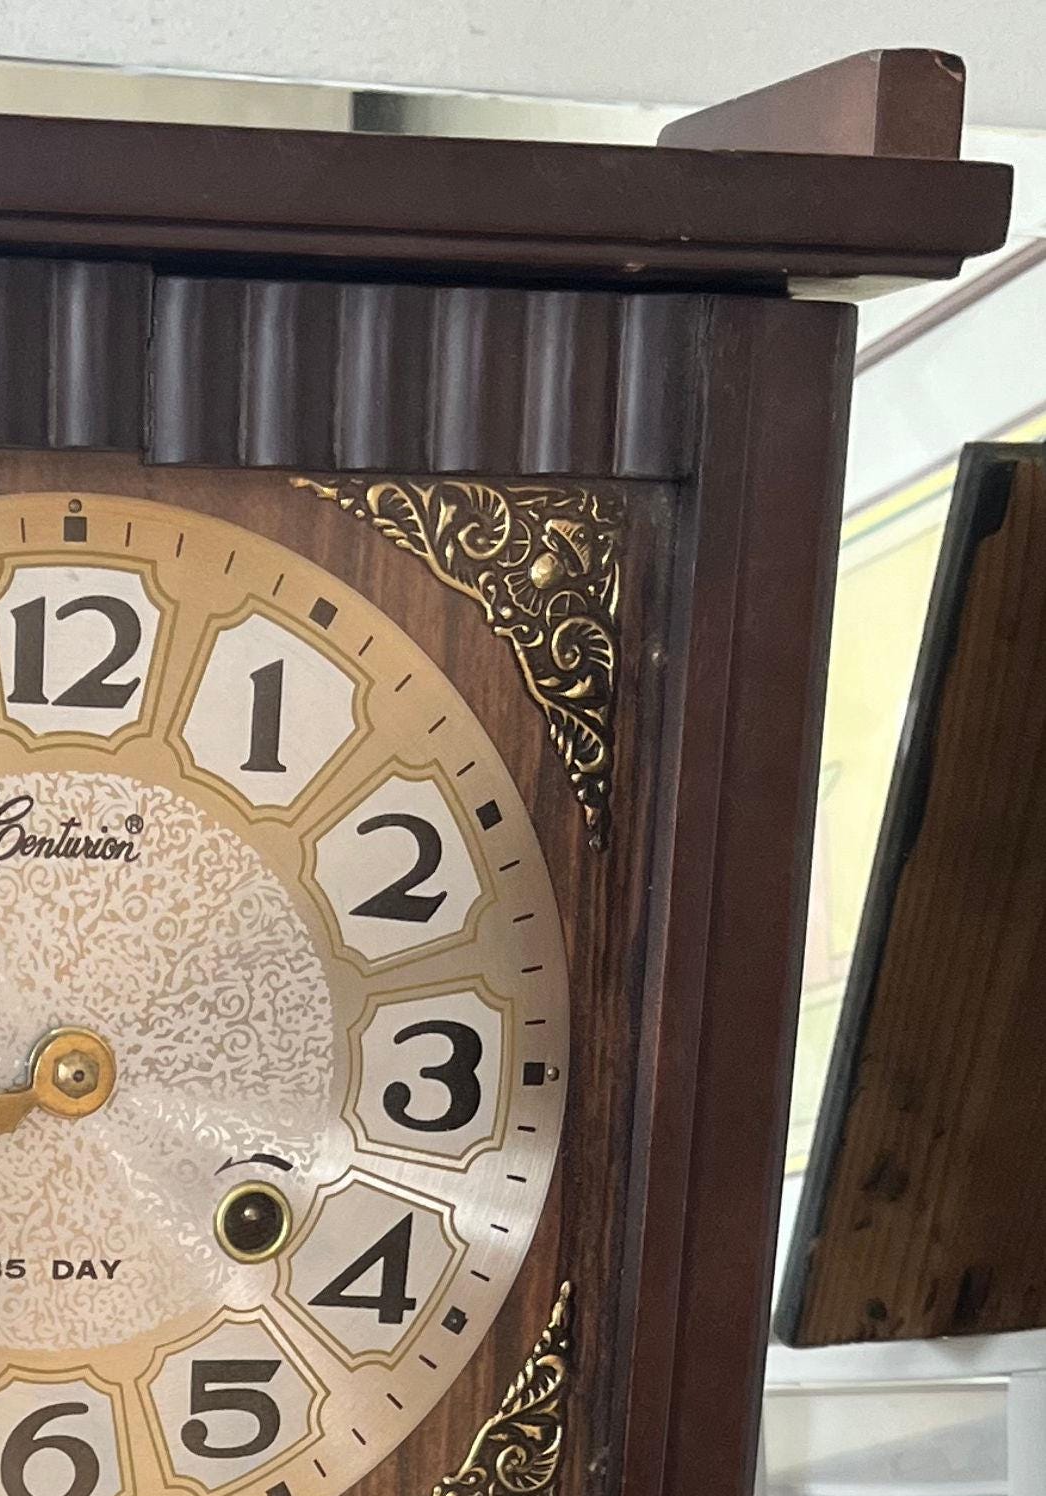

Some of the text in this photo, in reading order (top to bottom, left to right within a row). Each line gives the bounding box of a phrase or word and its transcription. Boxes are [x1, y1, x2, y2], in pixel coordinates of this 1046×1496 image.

[7, 595, 141, 709] 12
[240, 658, 287, 773] 1
[349, 813, 448, 923] 2
[383, 1020, 483, 1132] 3
[52, 1260, 122, 1281] DAY
[307, 1212, 417, 1324] 4
[180, 1360, 282, 1459] 5
